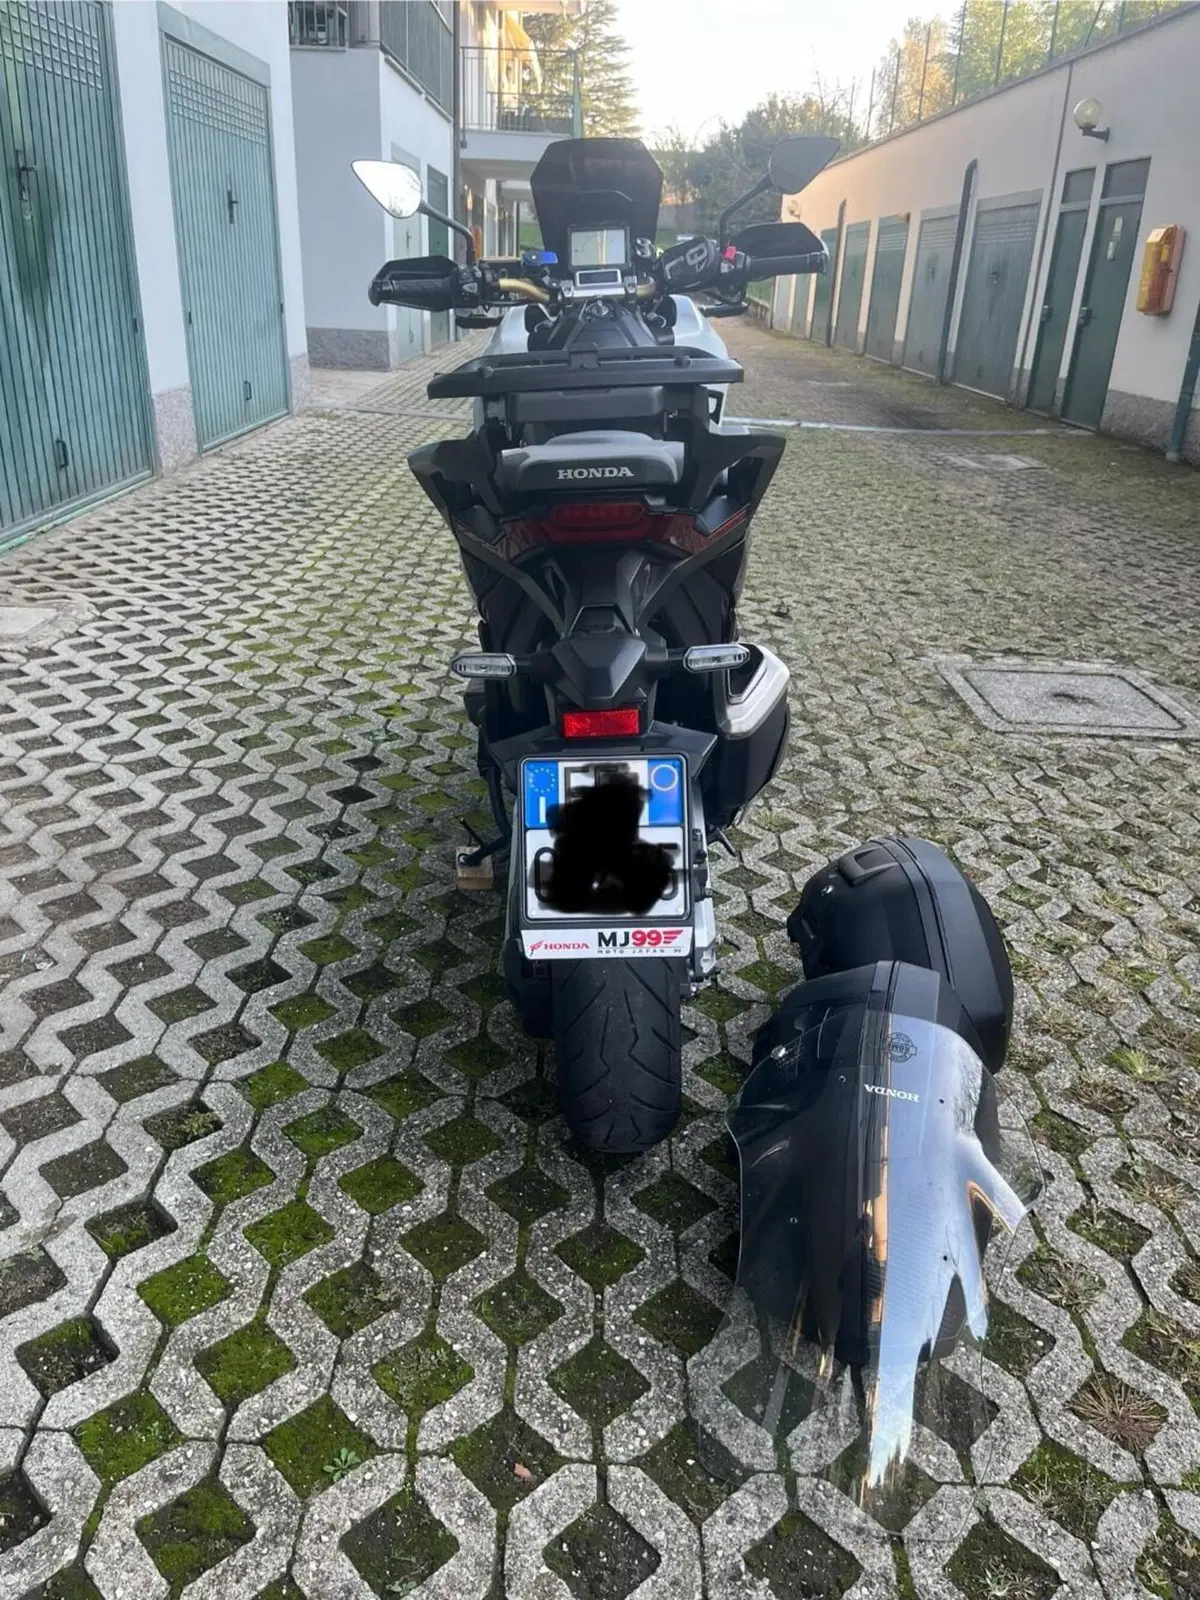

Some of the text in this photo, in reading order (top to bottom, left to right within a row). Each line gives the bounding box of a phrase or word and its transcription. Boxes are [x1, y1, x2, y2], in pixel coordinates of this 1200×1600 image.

[557, 466, 635, 480] HONDA
[544, 941, 590, 950] HONDA
[597, 930, 662, 948] MJ99
[864, 1083, 920, 1103] HONDA
